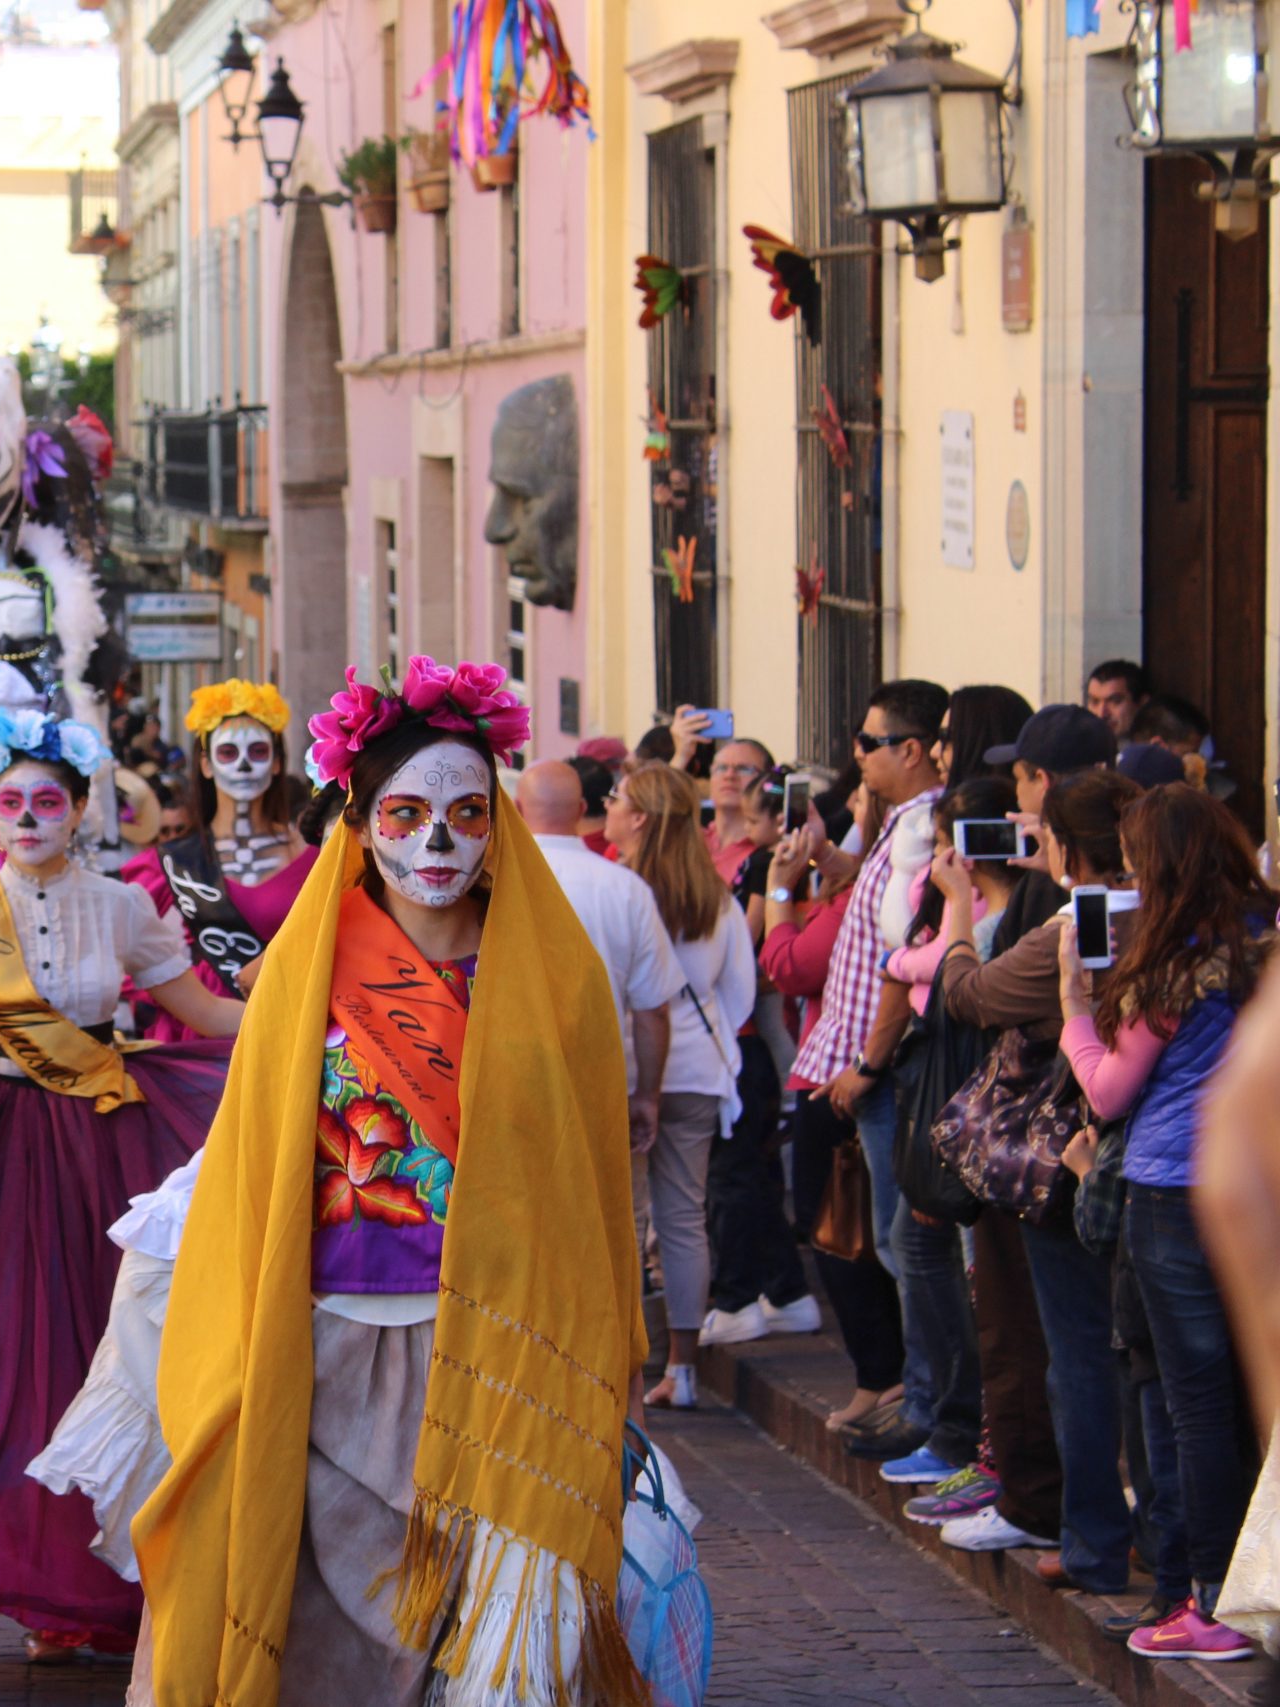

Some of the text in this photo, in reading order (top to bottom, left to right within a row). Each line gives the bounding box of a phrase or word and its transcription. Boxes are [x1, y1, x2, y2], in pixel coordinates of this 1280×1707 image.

[163, 854, 222, 919] La
[335, 993, 437, 1101] Restaurant
[358, 955, 457, 1082] Van
